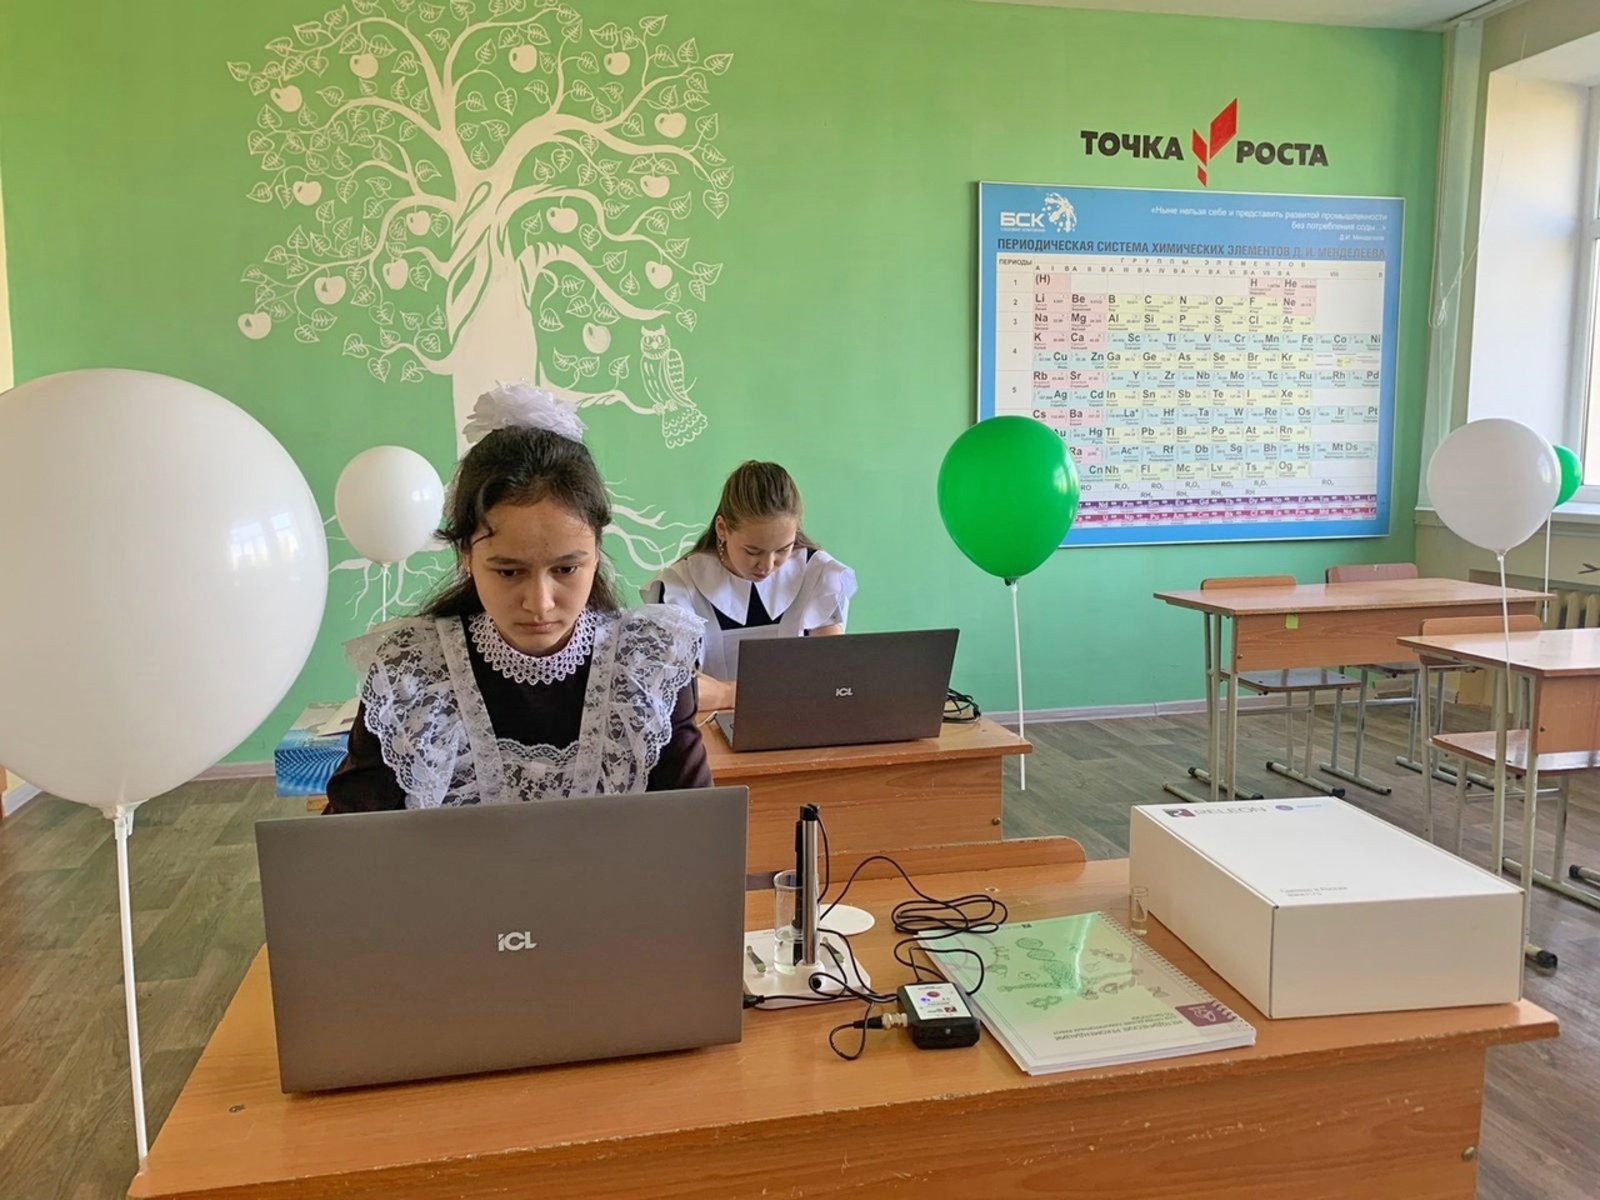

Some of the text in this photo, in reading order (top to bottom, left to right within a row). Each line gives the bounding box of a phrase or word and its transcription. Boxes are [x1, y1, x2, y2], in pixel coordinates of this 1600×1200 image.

[1080, 131, 1329, 166] ТОЧКА РОСТА
[1000, 212, 1045, 227] БСК
[1208, 208, 1227, 216] себе
[1235, 210, 1284, 219] представить
[1285, 211, 1319, 219] развитой
[1321, 213, 1387, 221] промышленности
[1291, 221, 1304, 229] без
[1306, 222, 1354, 231] потребления
[998, 239, 1093, 251] ПЕРИОДИЧЕСКАЯ
[1097, 241, 1148, 253] СИСТЕМА
[1152, 243, 1224, 254] ХИМИЧЕСКИХ
[1228, 245, 1289, 256] ЭЛЕМЕНТОВ
[1320, 248, 1385, 258] МЕНДЕЛЕЕВА
[1036, 274, 1050, 285] (H)
[1251, 279, 1257, 287] H
[1285, 280, 1297, 288] He
[1036, 294, 1045, 303] Li
[1072, 294, 1085, 303] Be
[1109, 295, 1115, 304] B
[1145, 295, 1152, 304] C
[1180, 296, 1187, 304] N
[1215, 296, 1223, 305] O
[1250, 297, 1255, 305] F
[1284, 298, 1296, 306] Ne
[1035, 314, 1048, 322] Na
[1071, 314, 1086, 323] Mg
[1144, 315, 1154, 323] Si
[1215, 315, 1221, 324] S
[1284, 317, 1294, 325] Ar
[1035, 333, 1041, 341] K
[1071, 334, 1084, 342] Ca
[1128, 334, 1140, 342] Sc
[1167, 334, 1176, 342] Ti
[1235, 335, 1245, 343] Cr
[1266, 335, 1279, 343] Mn
[1302, 335, 1313, 344] Fe
[1334, 335, 1347, 344] Co
[1371, 336, 1380, 344] Ni
[1054, 352, 1067, 361] Cu
[1091, 352, 1104, 361] Zn
[1107, 353, 1120, 361] Ga
[1143, 353, 1156, 361] Ge
[1179, 353, 1190, 361] As
[1214, 353, 1225, 361] Se
[1248, 353, 1258, 361] Br
[1282, 353, 1292, 361] Kr
[1034, 371, 1379, 380] Rb Sr Y Zr Nb Mo Tc Ru Rh Pd
[1054, 390, 1067, 401] Ag
[1091, 390, 1103, 399] Cd
[1107, 390, 1115, 399] In
[1143, 390, 1155, 398] Sn
[1178, 390, 1191, 398] Sb
[1214, 390, 1223, 398] Te
[1281, 390, 1293, 398] Xe
[1033, 410, 1046, 419] Cs
[1070, 409, 1083, 418] Ba
[1164, 409, 1174, 417] Hf
[1234, 408, 1244, 416] W
[1265, 408, 1277, 416] Re
[1298, 407, 1310, 416] Os
[1368, 407, 1377, 415] Pt
[1089, 428, 1102, 438] Hg
[1142, 427, 1154, 436] Pb
[1177, 427, 1186, 435] Bi
[1212, 426, 1224, 435] Po
[1246, 426, 1256, 434] At
[1280, 426, 1292, 434] Rn
[1070, 447, 1082, 455] Ra
[1163, 445, 1174, 453] Rf
[1230, 444, 1242, 454] Sg
[1264, 444, 1276, 452] Bh
[1298, 444, 1310, 452] Hs
[1332, 443, 1343, 451] Mt
[1346, 443, 1358, 451] Ds
[1089, 466, 1103, 474] Cn
[1105, 466, 1119, 474] Nh
[1177, 464, 1190, 472] Mc
[1211, 464, 1222, 472] Lv
[1246, 463, 1256, 471] Ts
[1279, 462, 1292, 471] Og
[835, 687, 854, 697] ICL
